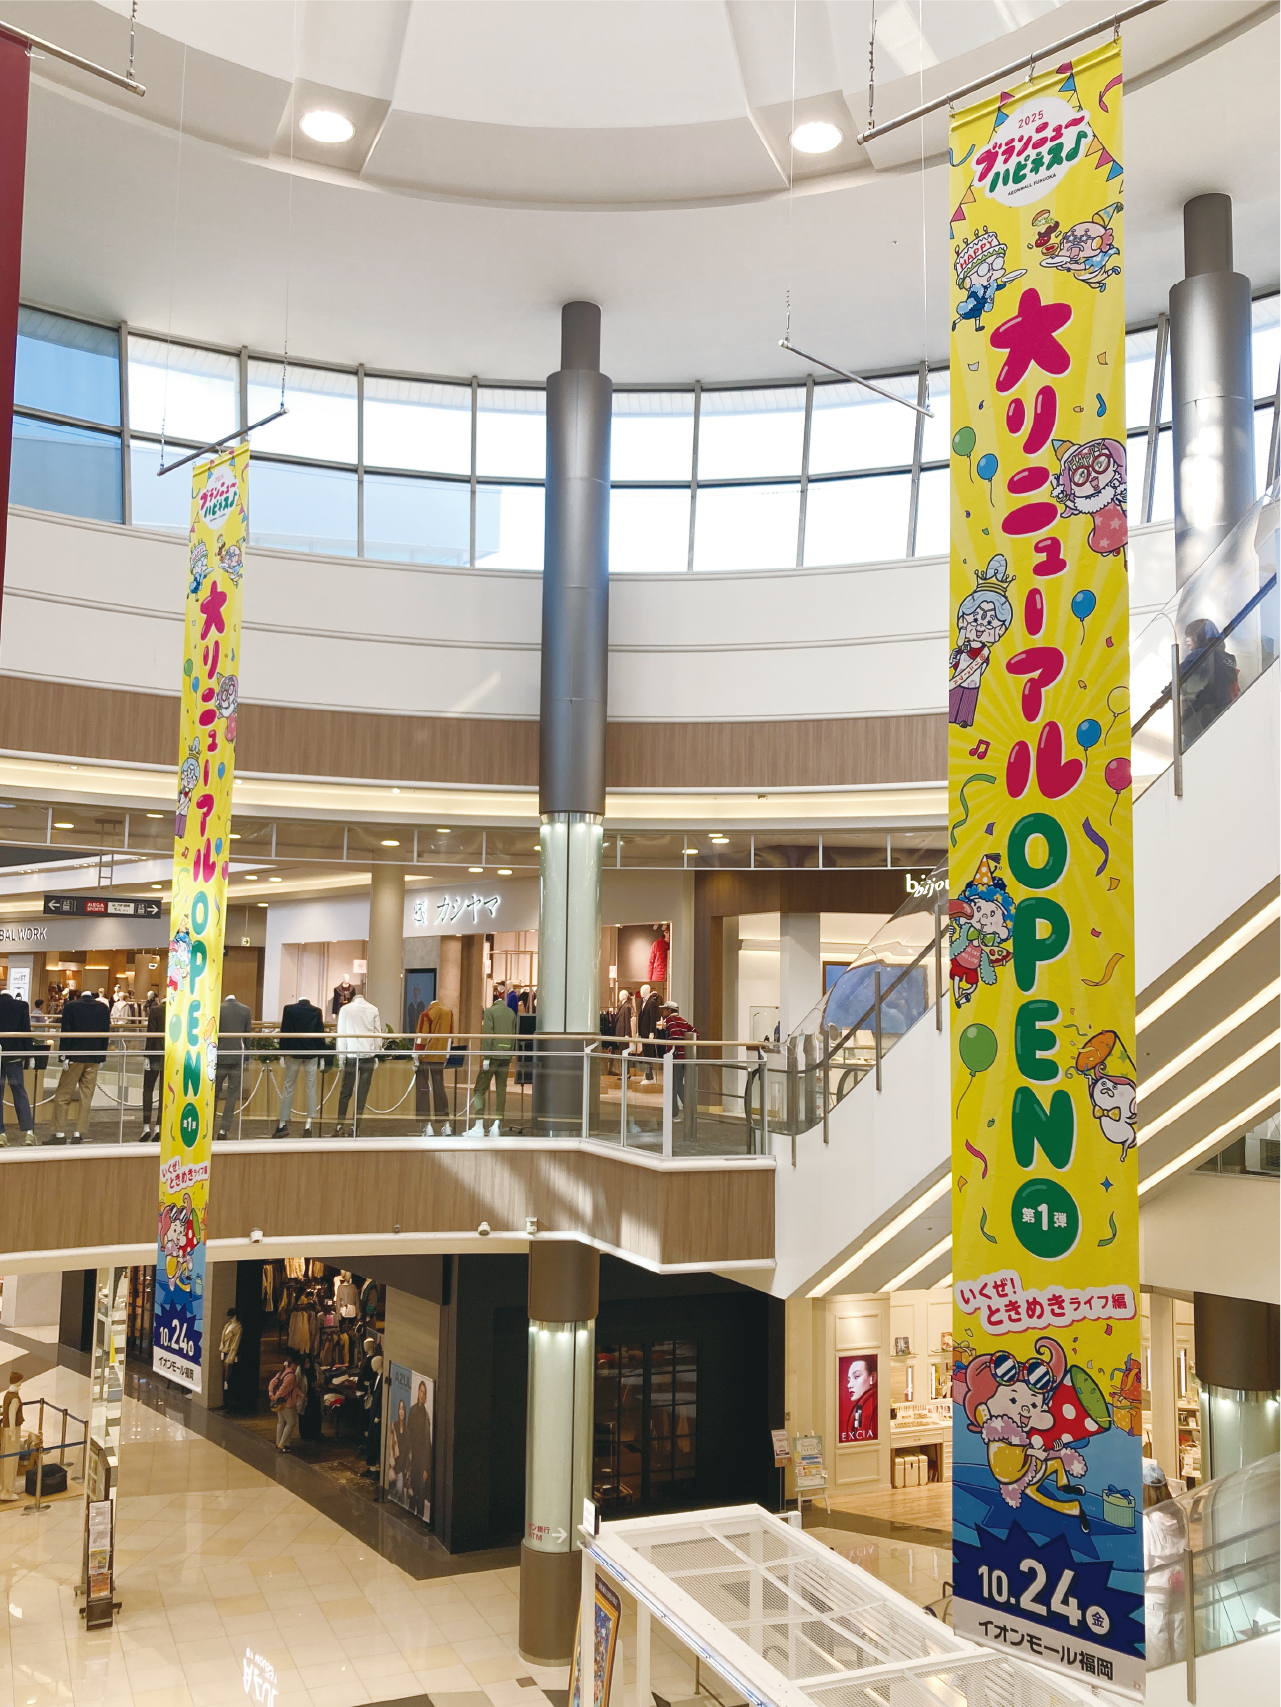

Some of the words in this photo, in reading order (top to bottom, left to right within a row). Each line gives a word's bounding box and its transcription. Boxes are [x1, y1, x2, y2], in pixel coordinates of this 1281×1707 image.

[1018, 110, 1044, 129] 2025
[975, 115, 1085, 183] ブランニュー
[1033, 173, 1056, 186] FUKUOKA
[960, 238, 994, 270] HAPPY
[434, 894, 500, 924] カシヤマ
[17, 926, 47, 941] WORK
[1022, 1203, 1067, 1231] 第1弾
[987, 1293, 1128, 1326] ときめきライフ編
[395, 1371, 412, 1390] AZUL
[841, 1429, 874, 1441] EXCIA
[978, 1620, 1114, 1681] イオンモール福岡
